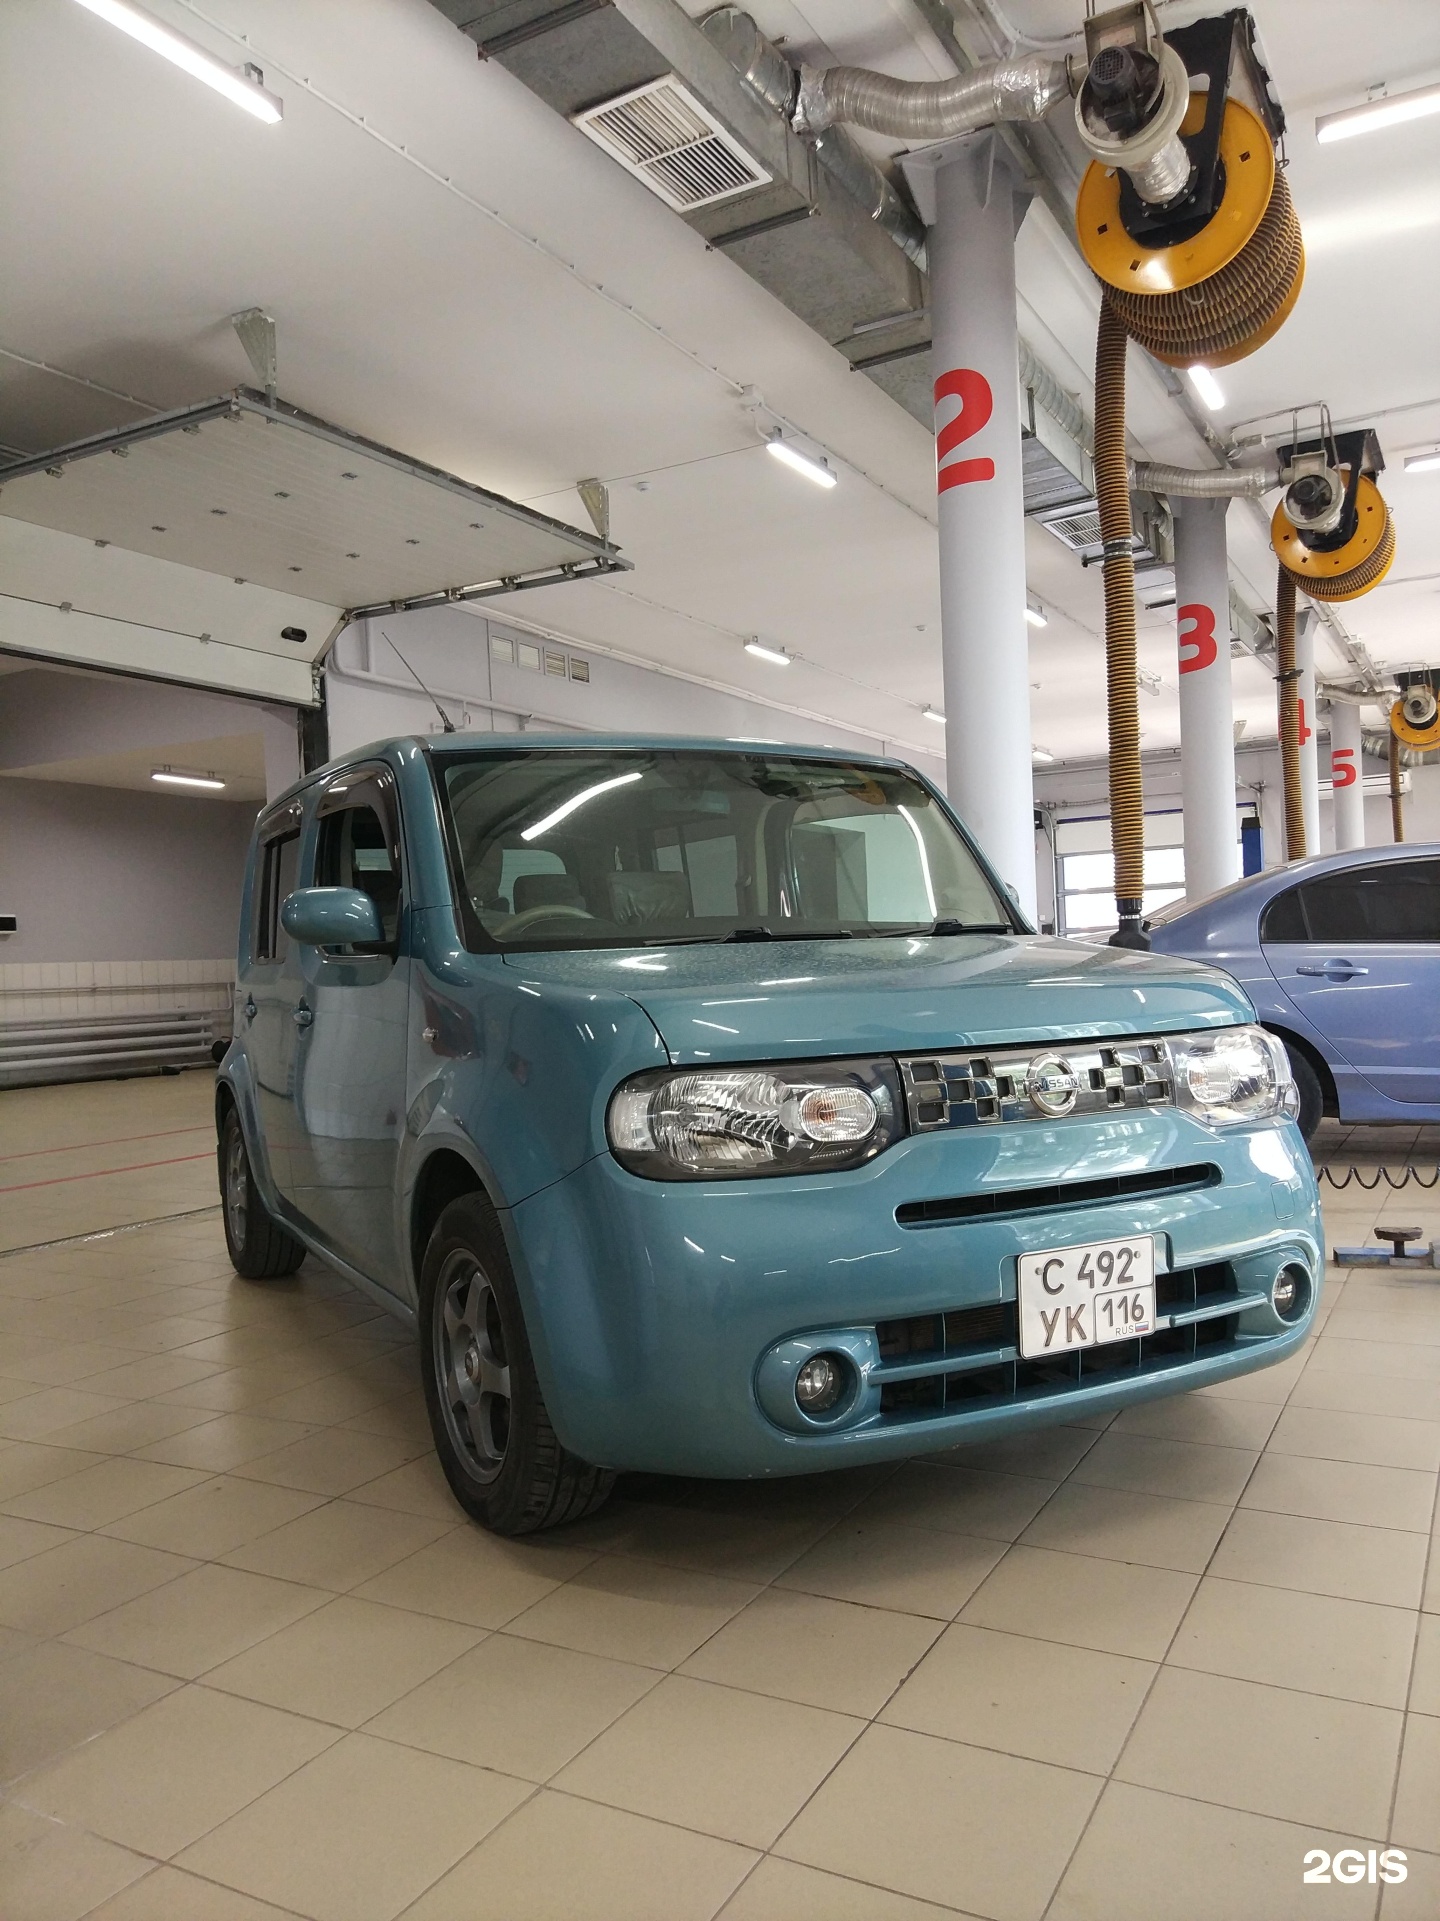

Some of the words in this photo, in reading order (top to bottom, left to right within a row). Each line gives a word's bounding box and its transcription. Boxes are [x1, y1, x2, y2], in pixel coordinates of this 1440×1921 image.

[934, 368, 995, 495] 2
[1177, 604, 1217, 675] 3
[1332, 749, 1356, 788] 5
[1033, 1078, 1079, 1090] NISSAN
[1078, 1247, 1133, 1289] 492
[1103, 1293, 1145, 1327] 116
[1115, 1325, 1134, 1336] RUS
